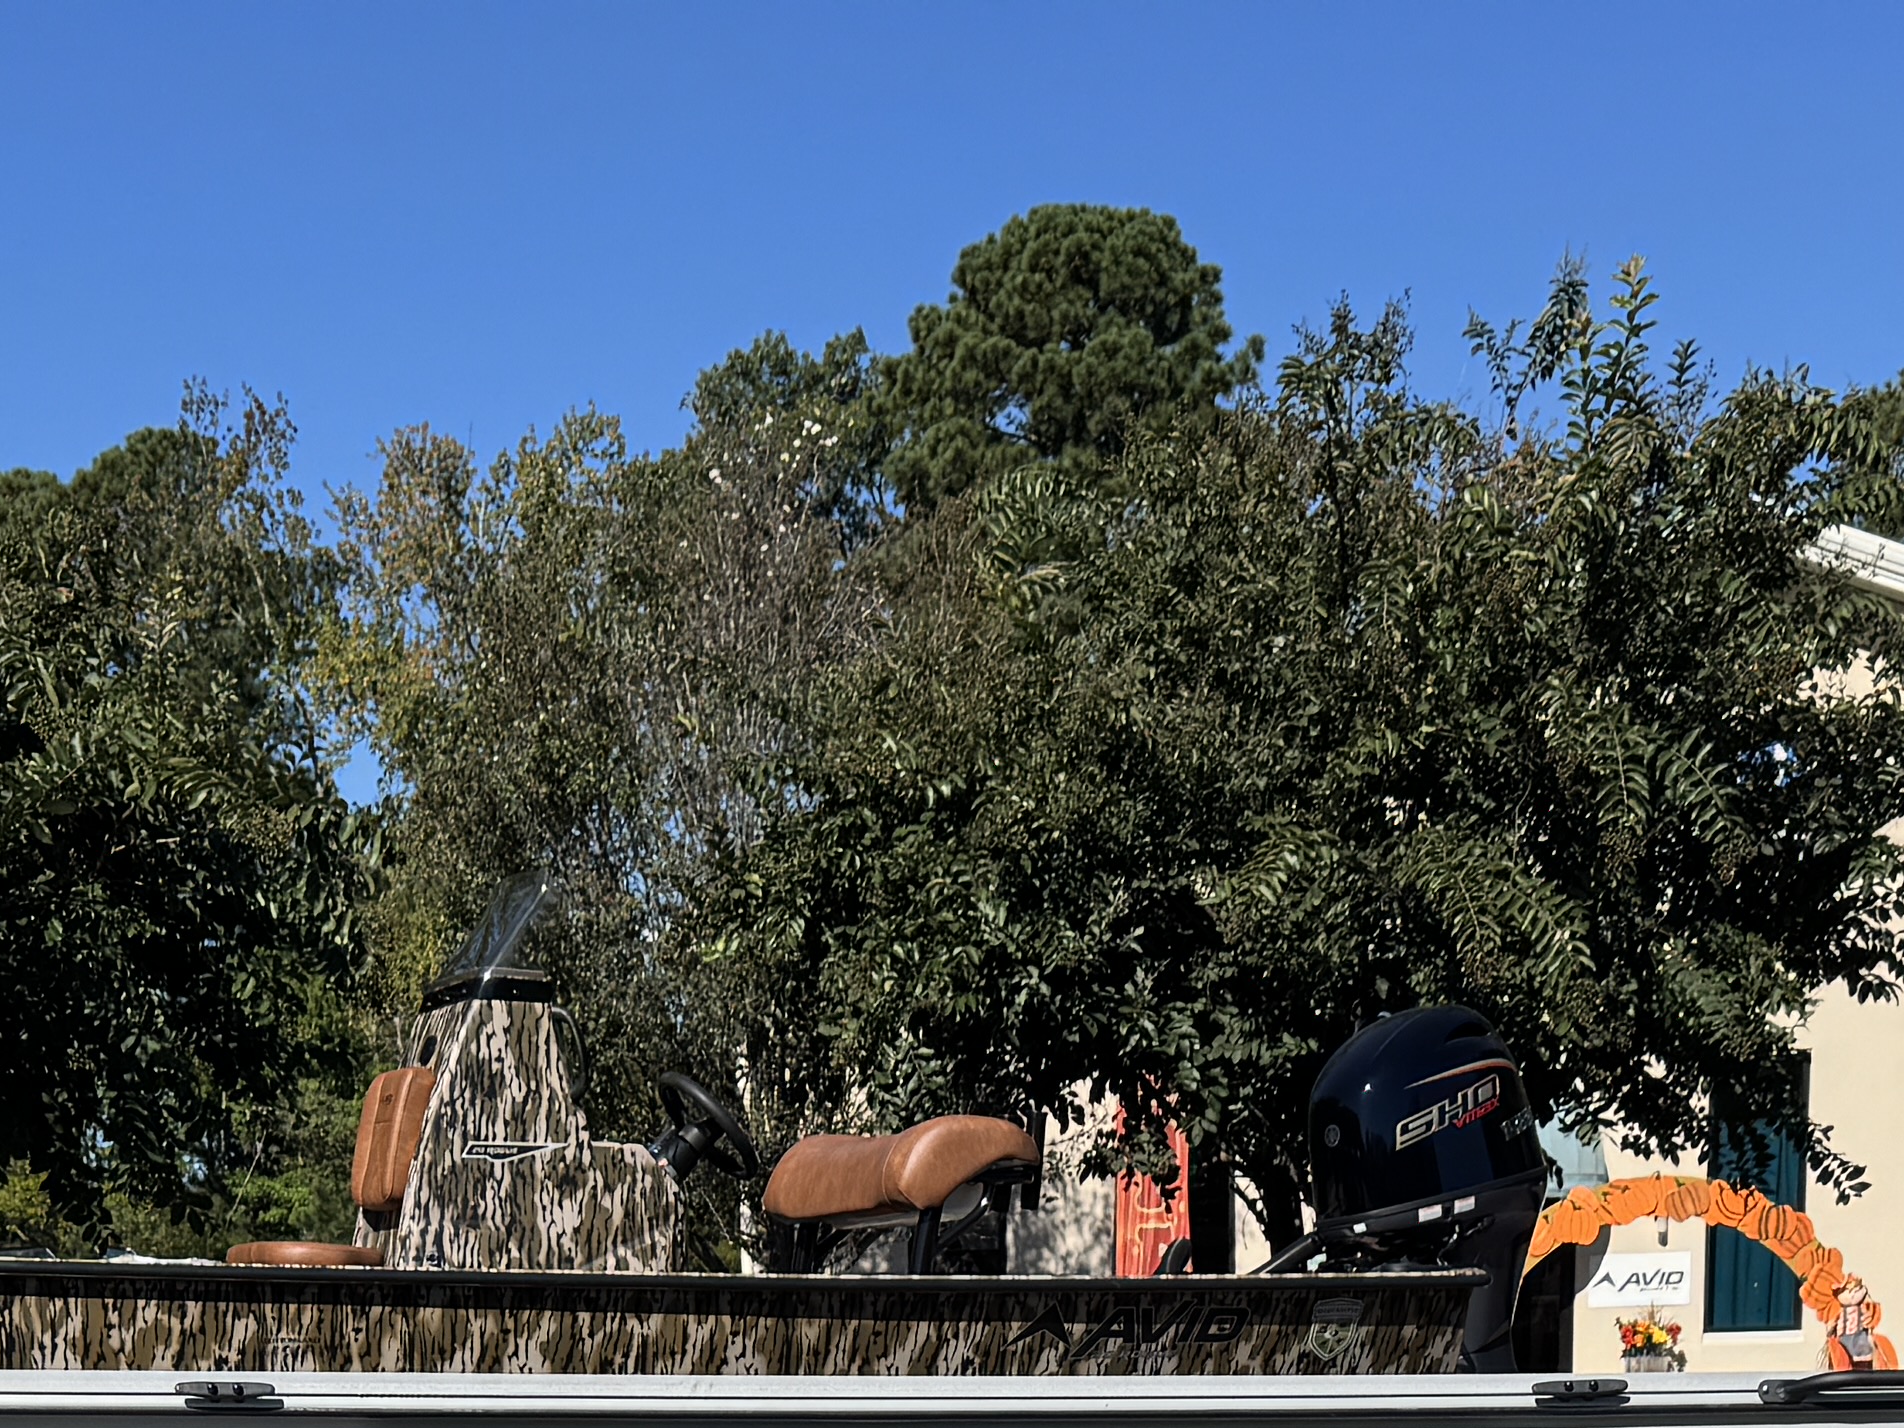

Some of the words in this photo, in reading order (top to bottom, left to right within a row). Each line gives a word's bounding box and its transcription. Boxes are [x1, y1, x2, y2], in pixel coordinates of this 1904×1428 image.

[1395, 1073, 1500, 1152] SHO
[1617, 1268, 1684, 1292] AVID
[1068, 1300, 1251, 1360] AVID
